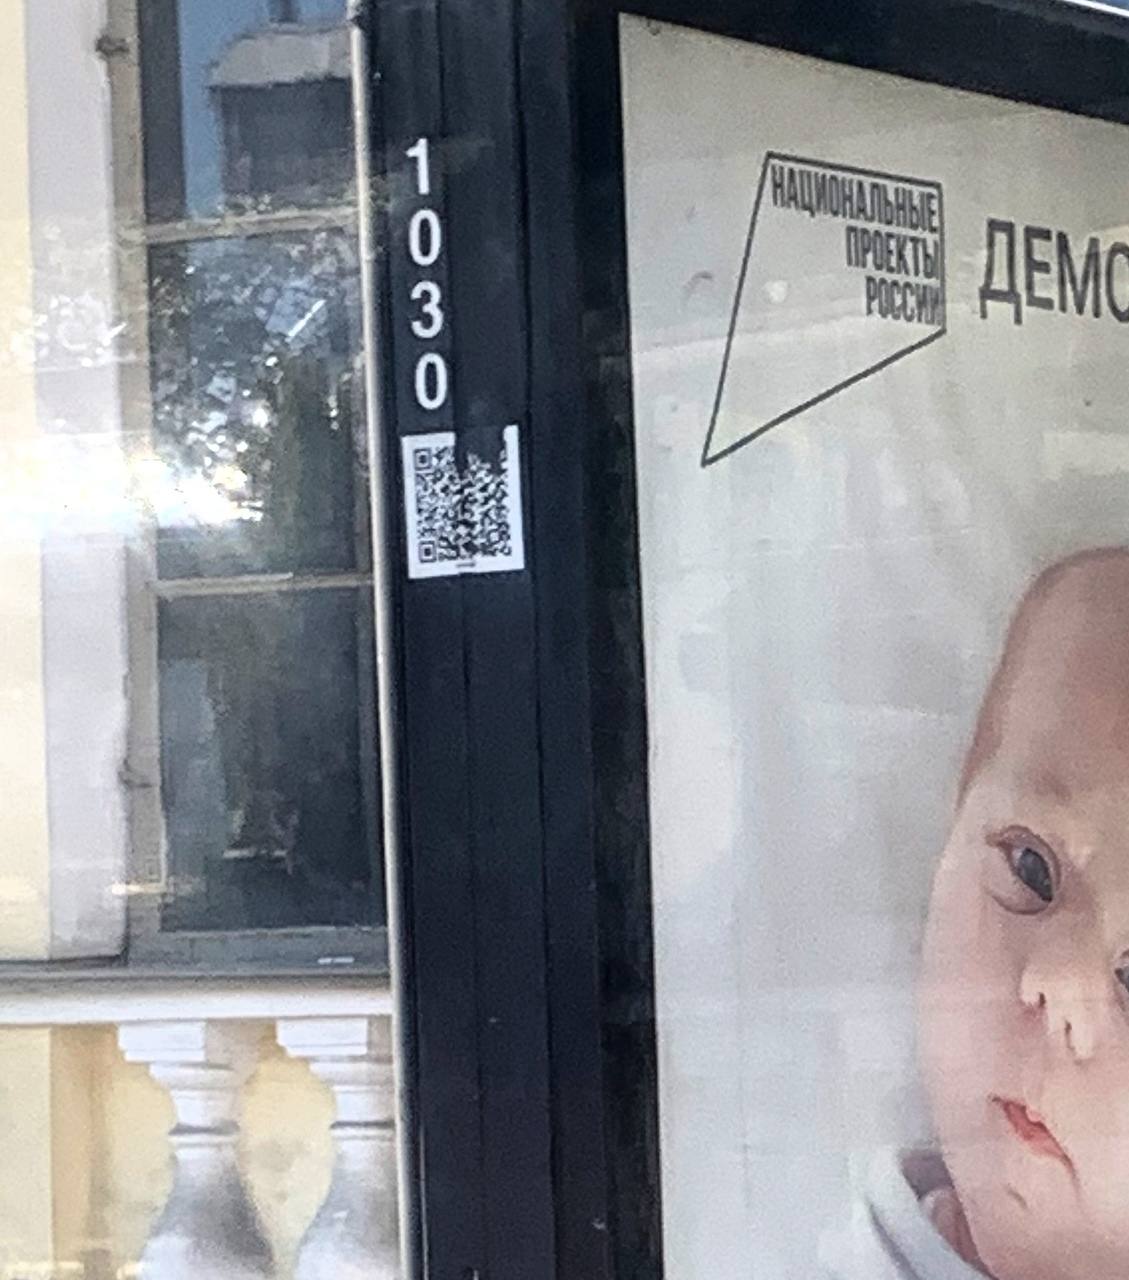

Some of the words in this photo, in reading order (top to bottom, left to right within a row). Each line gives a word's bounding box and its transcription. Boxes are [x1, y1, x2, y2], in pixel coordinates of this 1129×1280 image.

[771, 163, 938, 234] НАЦИОНАЛЬНЫЕ
[405, 137, 448, 411] 1030
[845, 224, 940, 281] ПРОЕКТЫ
[865, 275, 943, 326] РОССИИ
